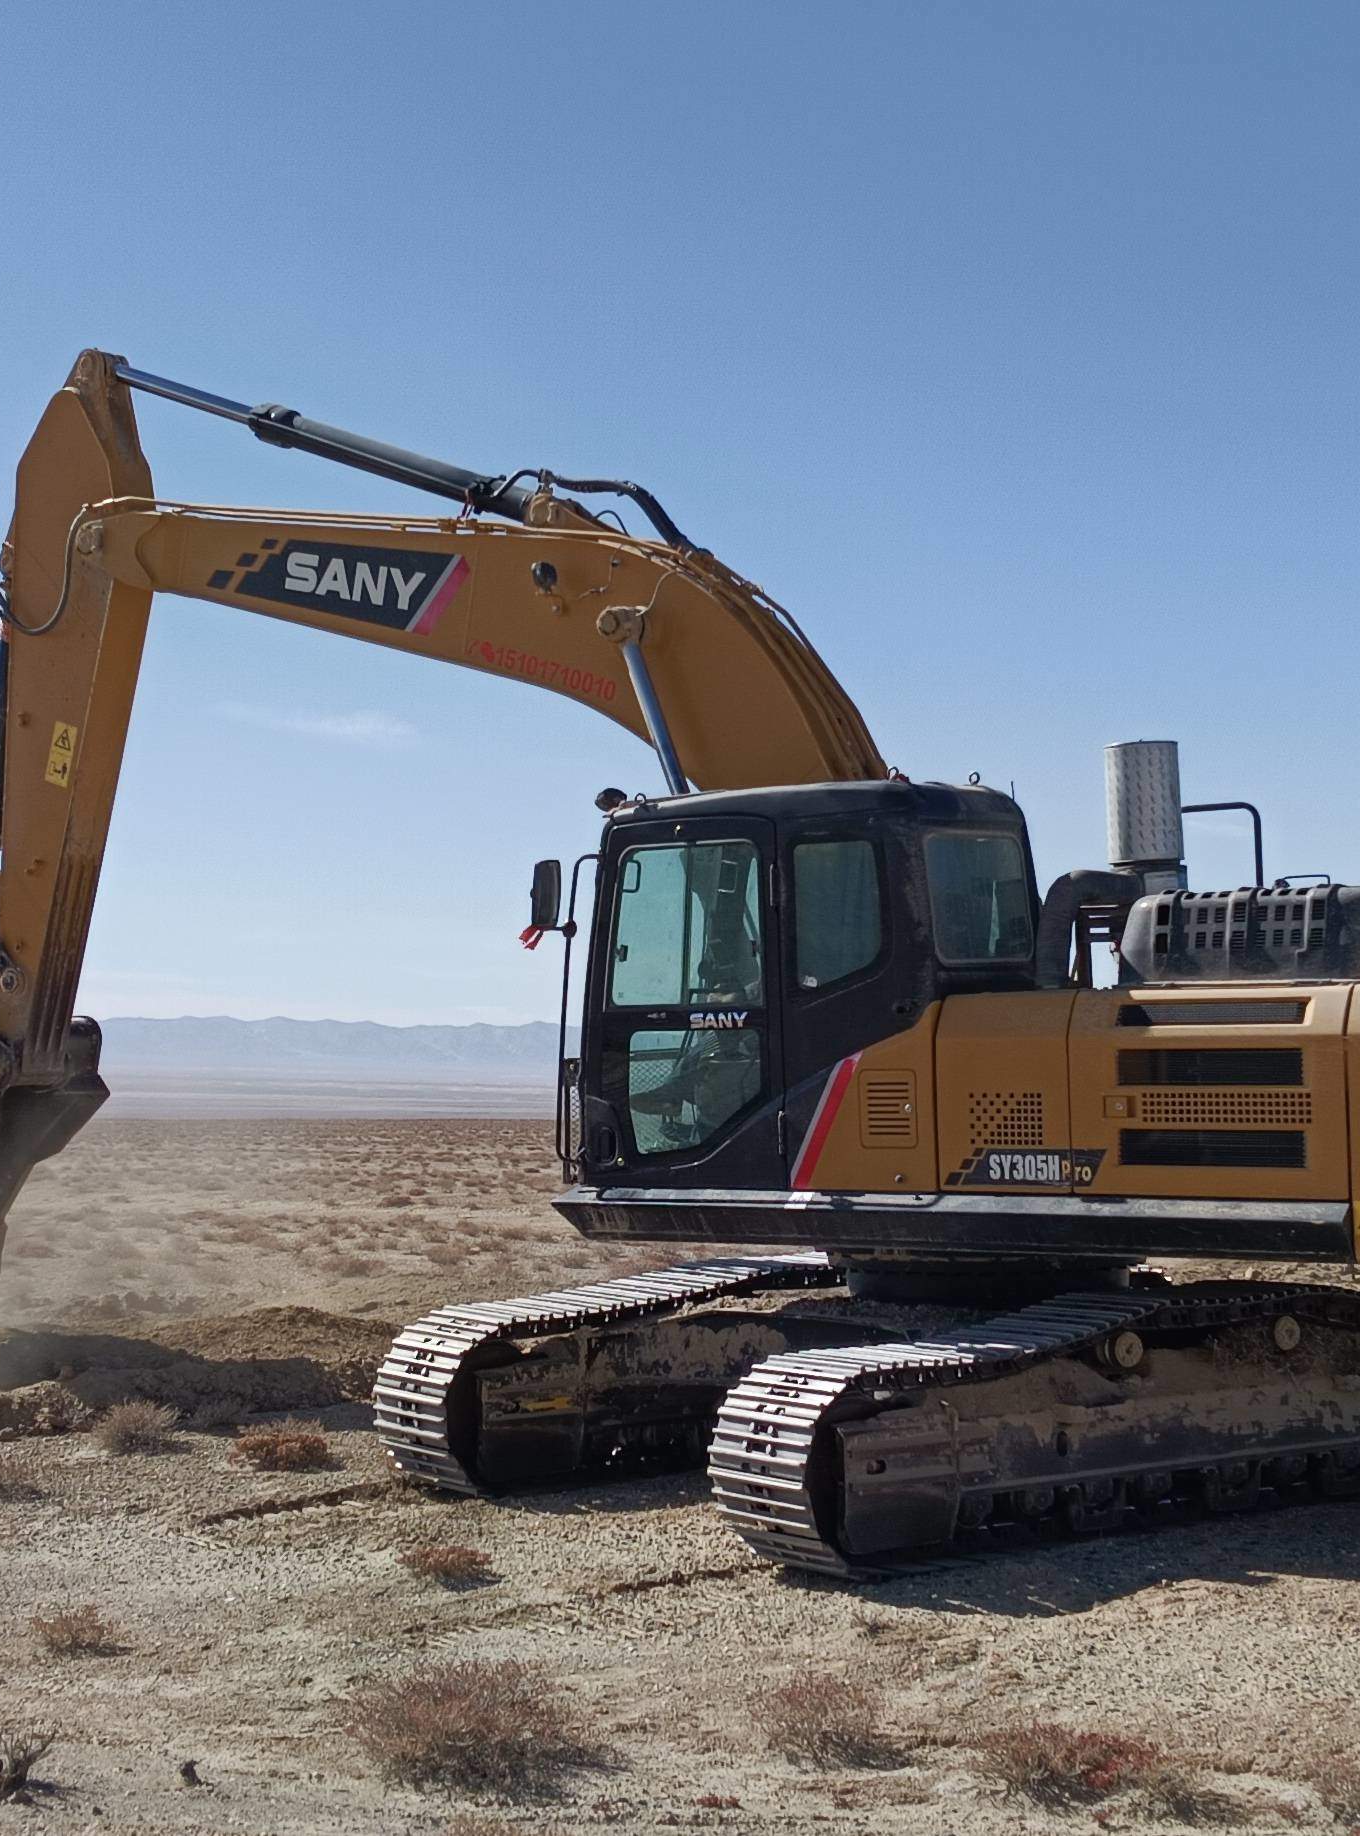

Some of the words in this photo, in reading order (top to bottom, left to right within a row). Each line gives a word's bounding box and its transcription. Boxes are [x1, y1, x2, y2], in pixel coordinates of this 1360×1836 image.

[285, 551, 426, 611] SANY
[496, 648, 616, 701] 15101710010
[689, 1011, 748, 1029] SANY
